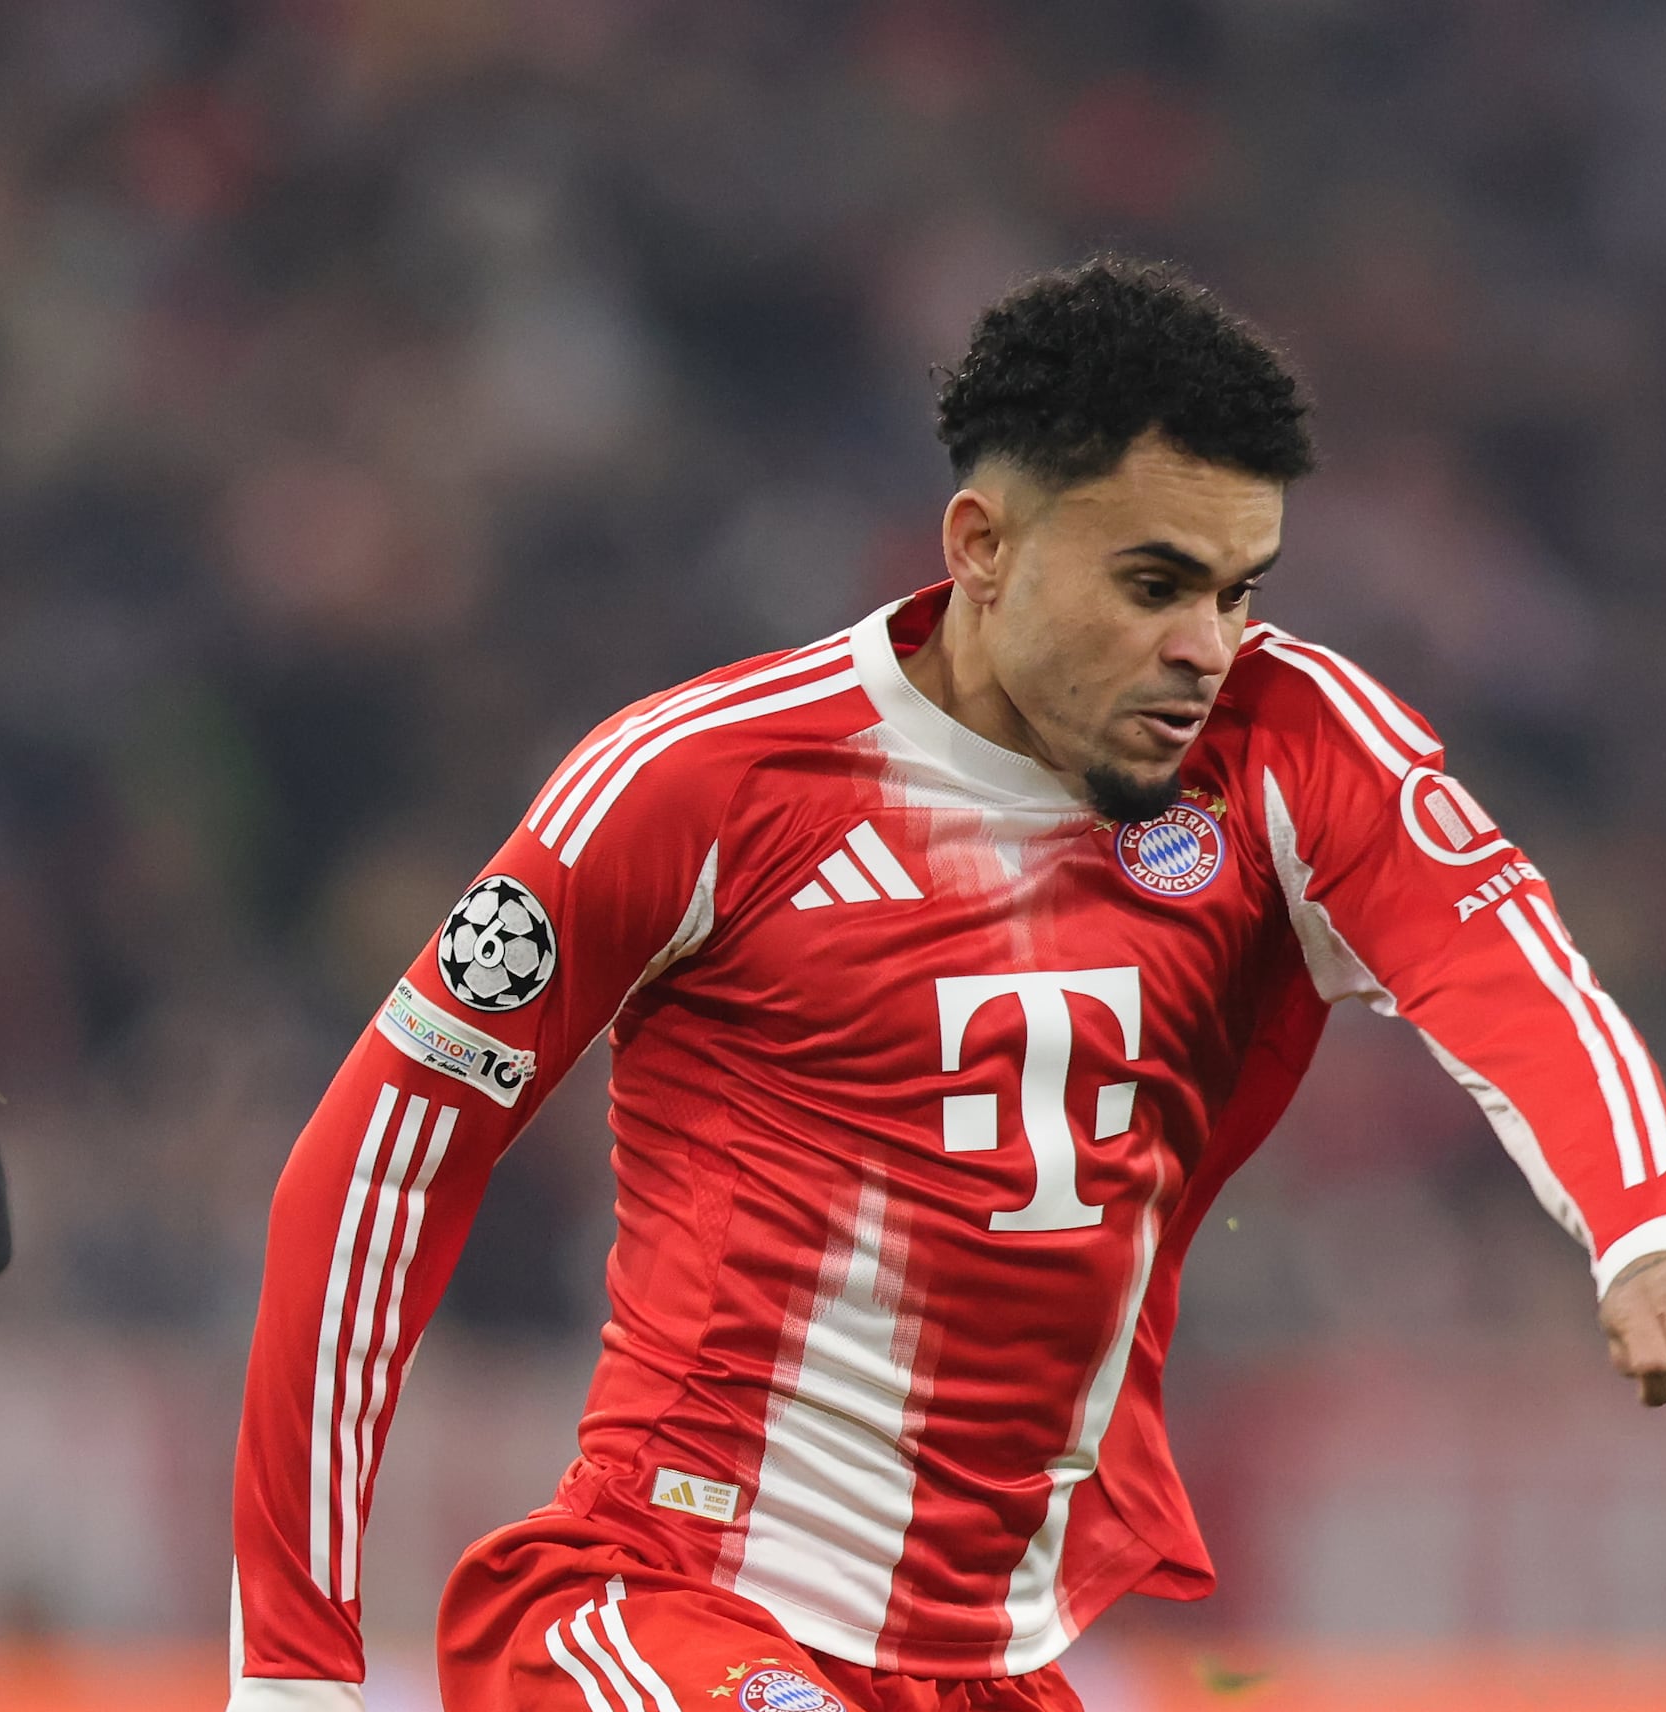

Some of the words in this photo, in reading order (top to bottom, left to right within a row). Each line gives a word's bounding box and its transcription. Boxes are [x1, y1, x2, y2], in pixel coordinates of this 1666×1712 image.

[1123, 828, 1141, 849] FC
[1130, 853, 1216, 890] MÜNCHEN
[388, 998, 477, 1064] FOUNDATION
